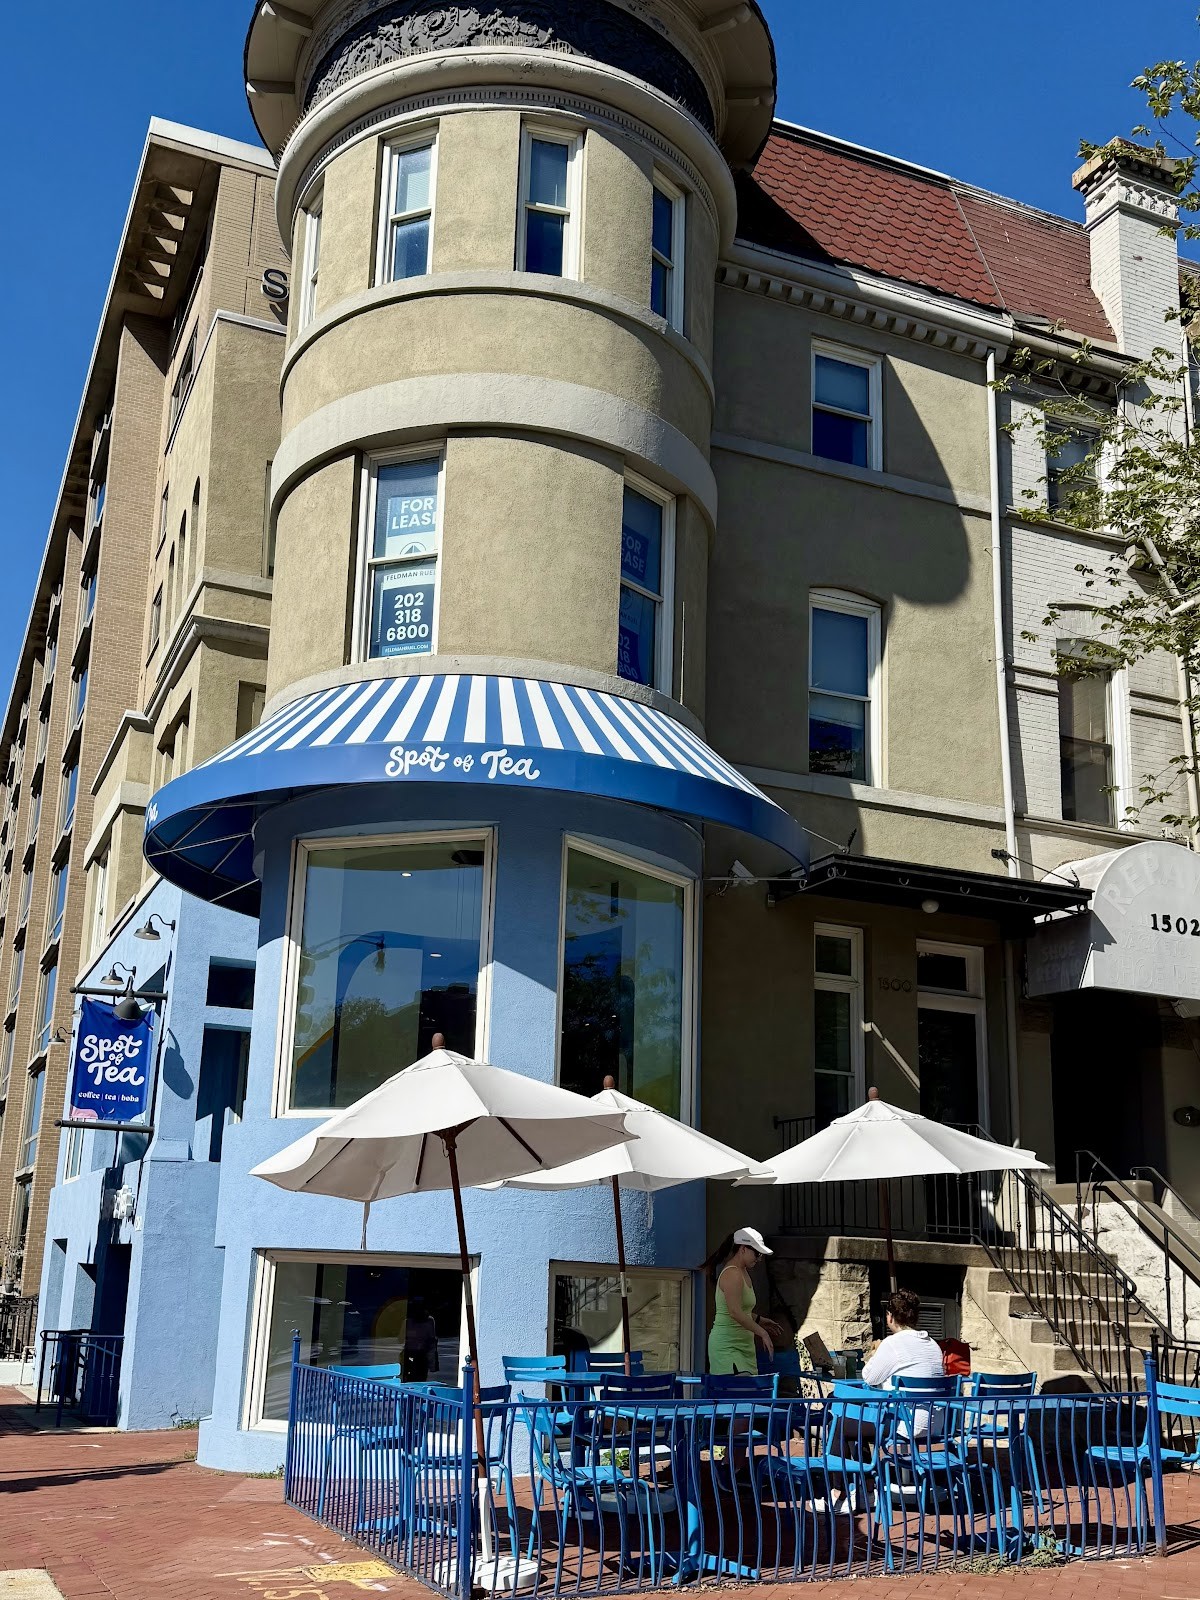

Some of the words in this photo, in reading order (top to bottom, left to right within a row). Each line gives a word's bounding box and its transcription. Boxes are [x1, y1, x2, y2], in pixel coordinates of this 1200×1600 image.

[401, 497, 435, 514] FOR
[386, 572, 418, 581] FELDMAN
[394, 592, 425, 609] 202
[394, 608, 422, 624] 318
[386, 623, 429, 641] 6800
[384, 745, 450, 777] Spot
[453, 754, 475, 773] of
[480, 748, 541, 780] Tea
[1150, 913, 1200, 937] 1502
[878, 976, 912, 993] 1500
[79, 1034, 143, 1063] Spot
[108, 1052, 125, 1066] of
[87, 1060, 145, 1086] Tea
[78, 1091, 101, 1100] coffee
[104, 1093, 117, 1101] tea
[121, 1094, 140, 1103] boba
